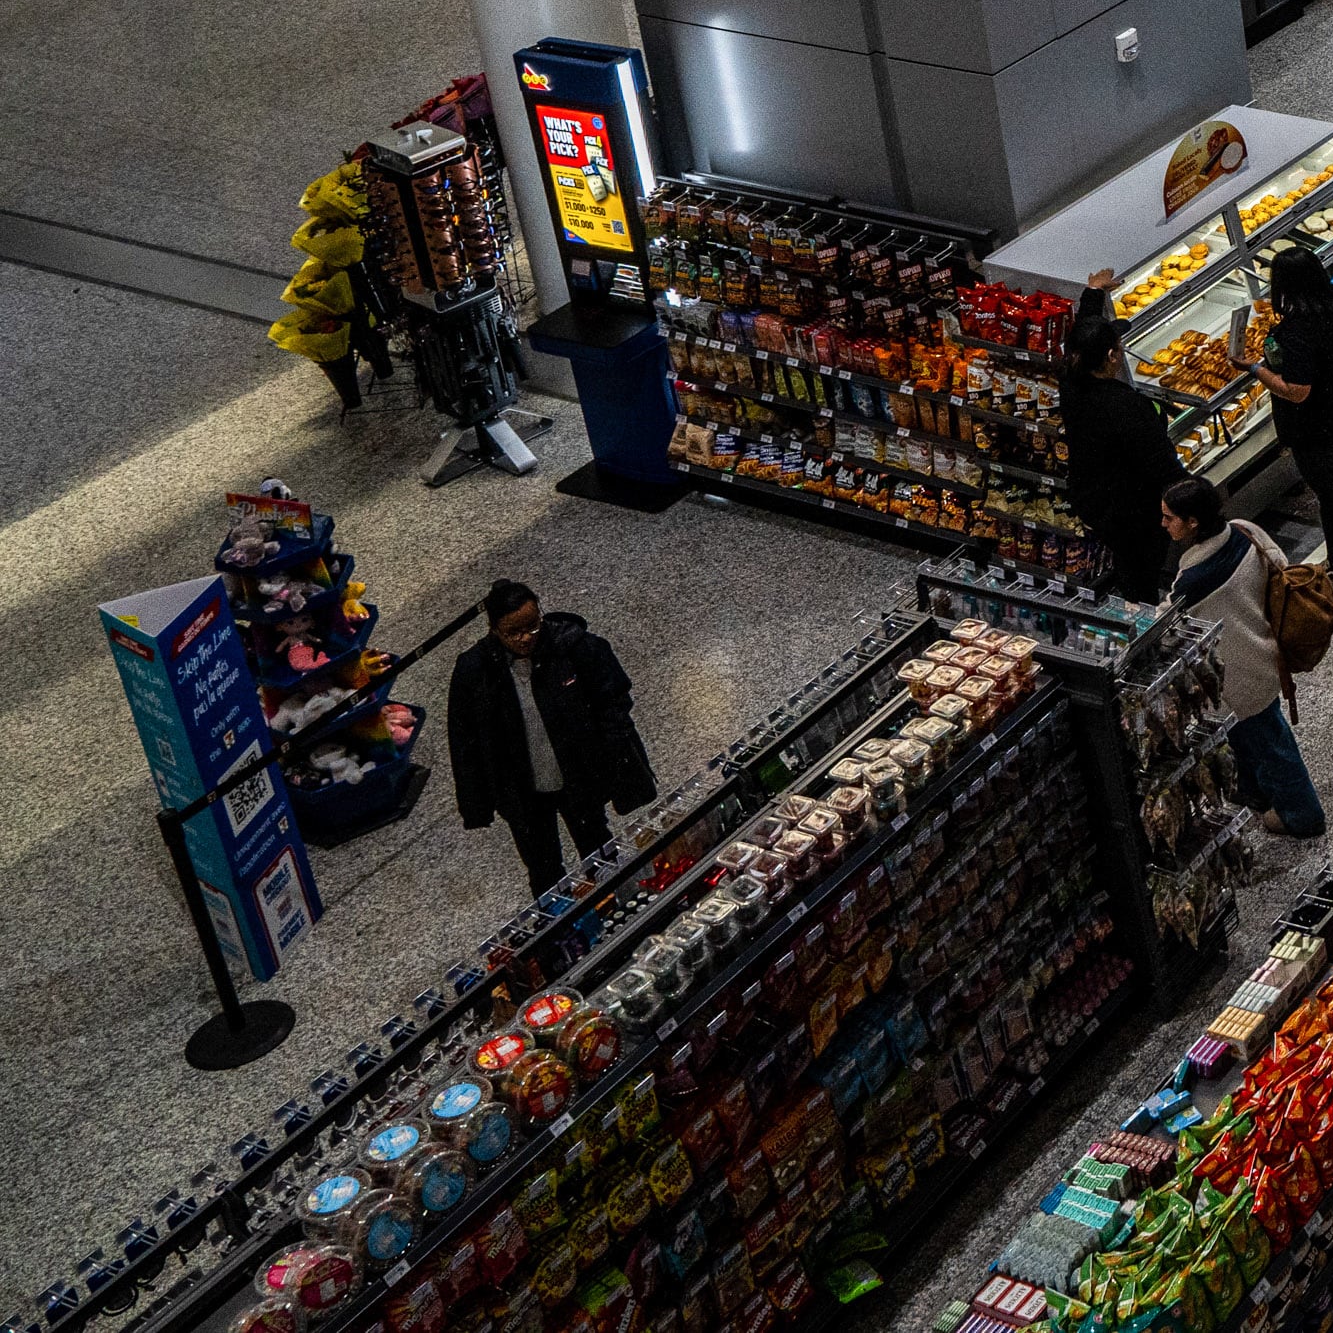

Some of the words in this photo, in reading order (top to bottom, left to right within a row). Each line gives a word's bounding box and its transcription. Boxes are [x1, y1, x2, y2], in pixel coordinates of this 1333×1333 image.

[543, 115, 583, 134] WHAT'S
[545, 128, 574, 146] YOUR
[549, 140, 580, 158] PICK?
[899, 265, 923, 281] KOPIKO
[193, 700, 210, 727] pas
